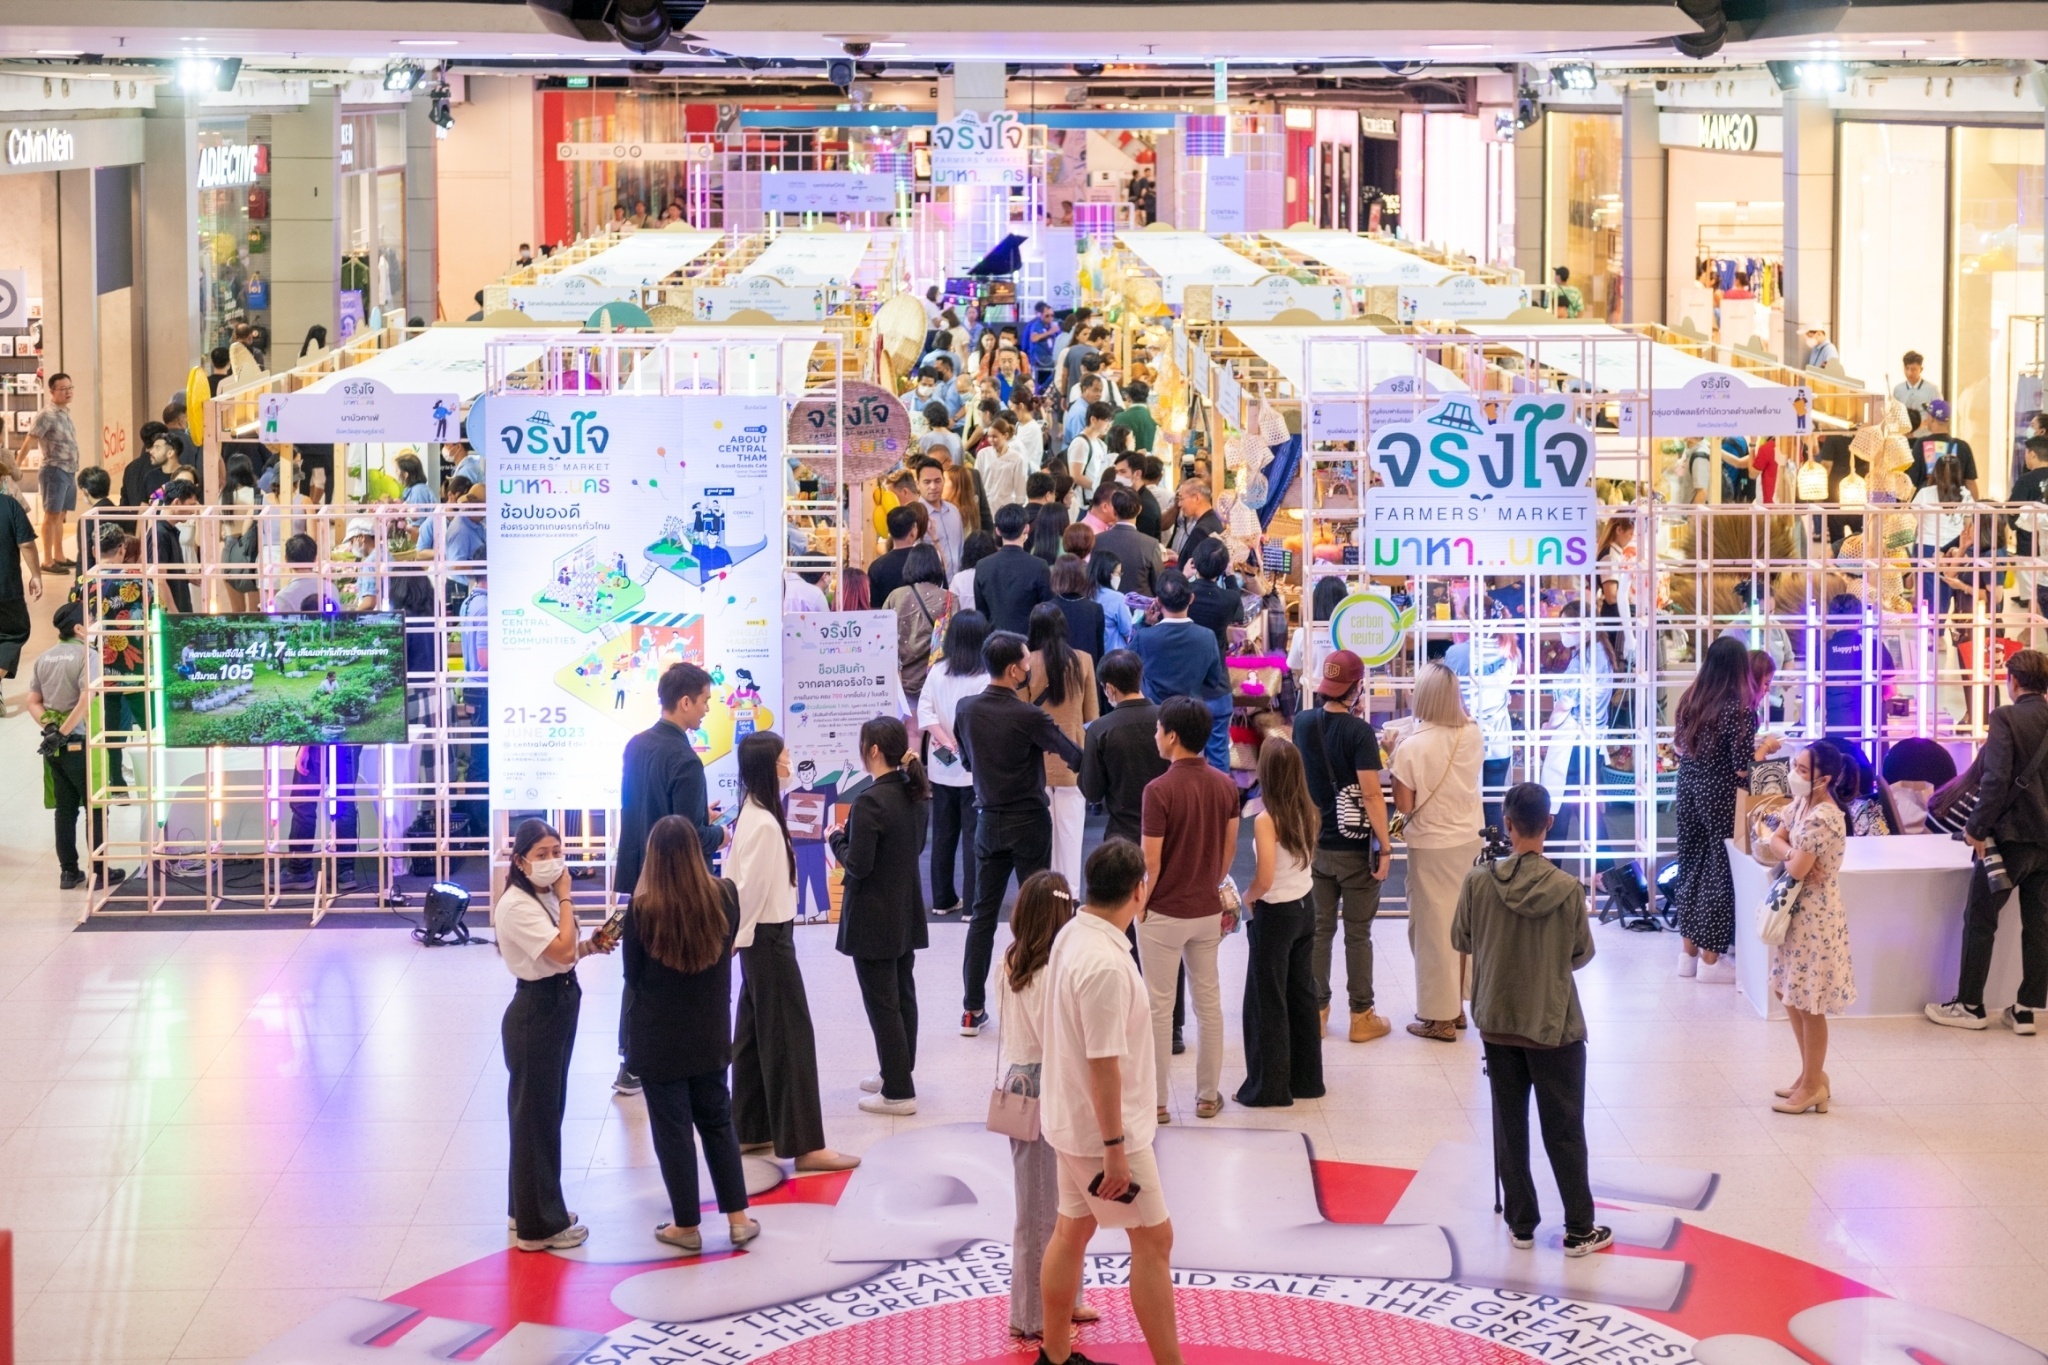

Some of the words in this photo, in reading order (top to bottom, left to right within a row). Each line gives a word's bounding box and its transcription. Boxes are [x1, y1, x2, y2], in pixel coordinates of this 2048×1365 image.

[1698, 113, 1757, 152] MANGO
[8, 127, 48, 166] Calvin
[47, 127, 74, 162] Klein
[197, 143, 260, 188] ADJECTIVE
[102, 421, 126, 460] Sale
[499, 410, 610, 455] จริงใจ
[730, 435, 768, 443] ABOUT
[718, 444, 767, 453] CENTRAL
[1377, 402, 1589, 489] จริงใจ
[737, 453, 767, 461] THAM
[499, 462, 560, 472] FARMERS'
[562, 462, 610, 472] MARKET
[500, 502, 581, 519] ช้อปของดี
[1374, 506, 1487, 521] FARMERS'
[1498, 506, 1589, 521] MARKET
[500, 520, 611, 531] ส่งตรงจากเกษตรกรทั่วไทย
[502, 618, 550, 627] CENTRAL
[1350, 613, 1384, 629] carbon
[502, 628, 532, 636] THAM
[820, 620, 862, 639] จริงใจ
[502, 637, 577, 645] COMMUNITIES
[1350, 631, 1385, 645] neutral
[244, 641, 287, 659] 41.7
[1831, 644, 1853, 655] Happy
[1853, 643, 1861, 652] to
[219, 664, 254, 681] 105
[818, 662, 866, 675] ช็อปสินค้า
[797, 676, 874, 690] จากตลาดจริงใจ
[503, 706, 568, 724] 21-25
[504, 728, 544, 738] JUNE
[548, 727, 586, 738] 2023
[513, 740, 567, 748] centralwOrld
[1230, 1273, 1334, 1299] SALE
[1379, 1278, 1464, 1306] THE
[1364, 1291, 1446, 1320] THE
[761, 1312, 844, 1342] THE
